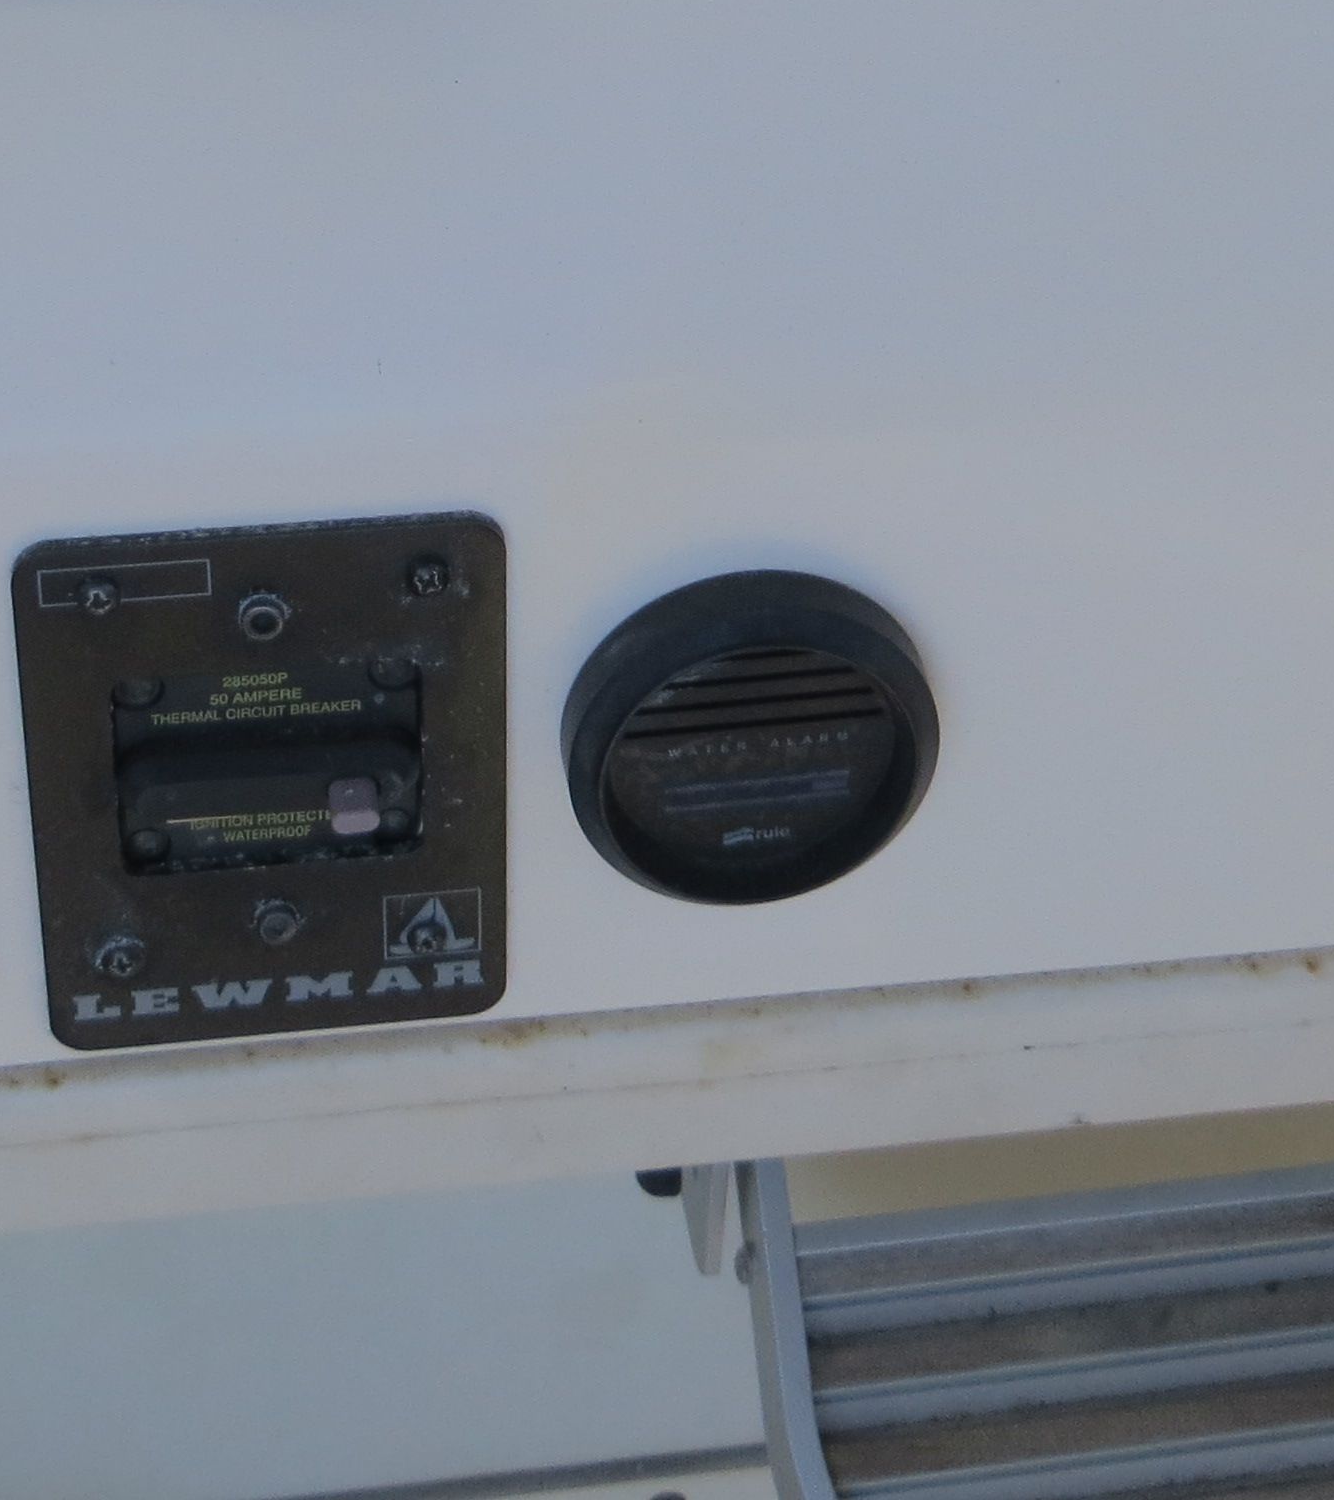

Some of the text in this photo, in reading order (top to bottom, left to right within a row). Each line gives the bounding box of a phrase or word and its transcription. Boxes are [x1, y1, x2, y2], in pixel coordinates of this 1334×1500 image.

[209, 687, 303, 706] 50 AMPERE
[151, 699, 362, 725] THERMAL CIRCUIT BREAKER
[257, 809, 334, 826] PROTECTE
[222, 825, 312, 844] WATERPROOF
[72, 959, 486, 1023] LEWMAR
